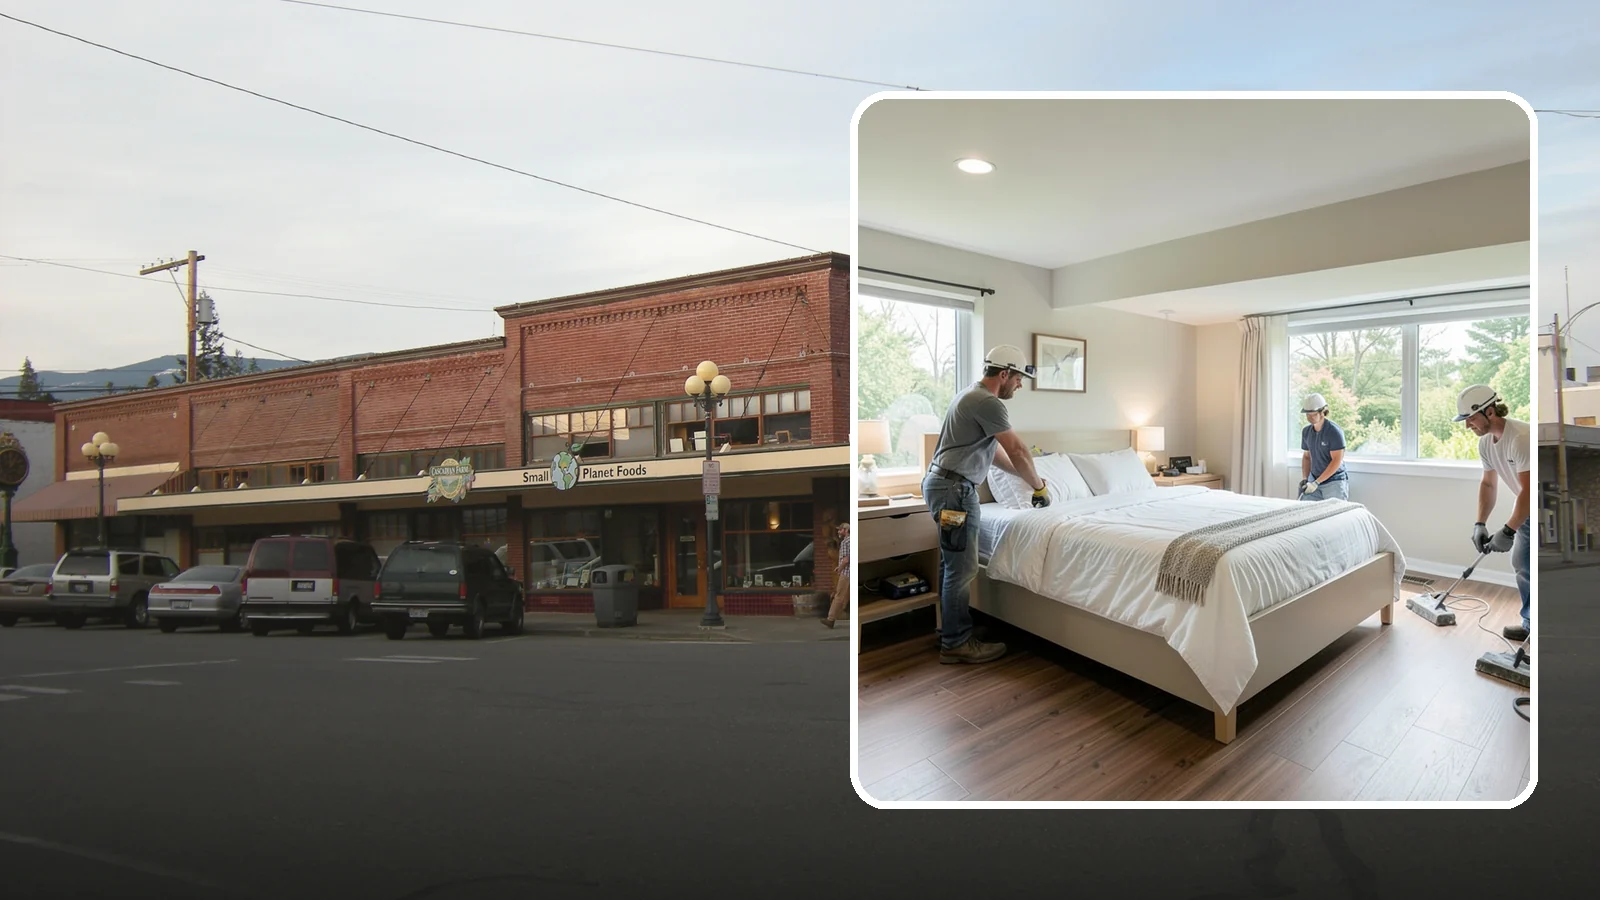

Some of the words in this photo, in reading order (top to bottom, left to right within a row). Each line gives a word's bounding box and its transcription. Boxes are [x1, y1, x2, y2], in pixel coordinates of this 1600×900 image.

[523, 470, 549, 483] Small
[583, 467, 614, 479] Planet
[617, 464, 647, 477] Foods
